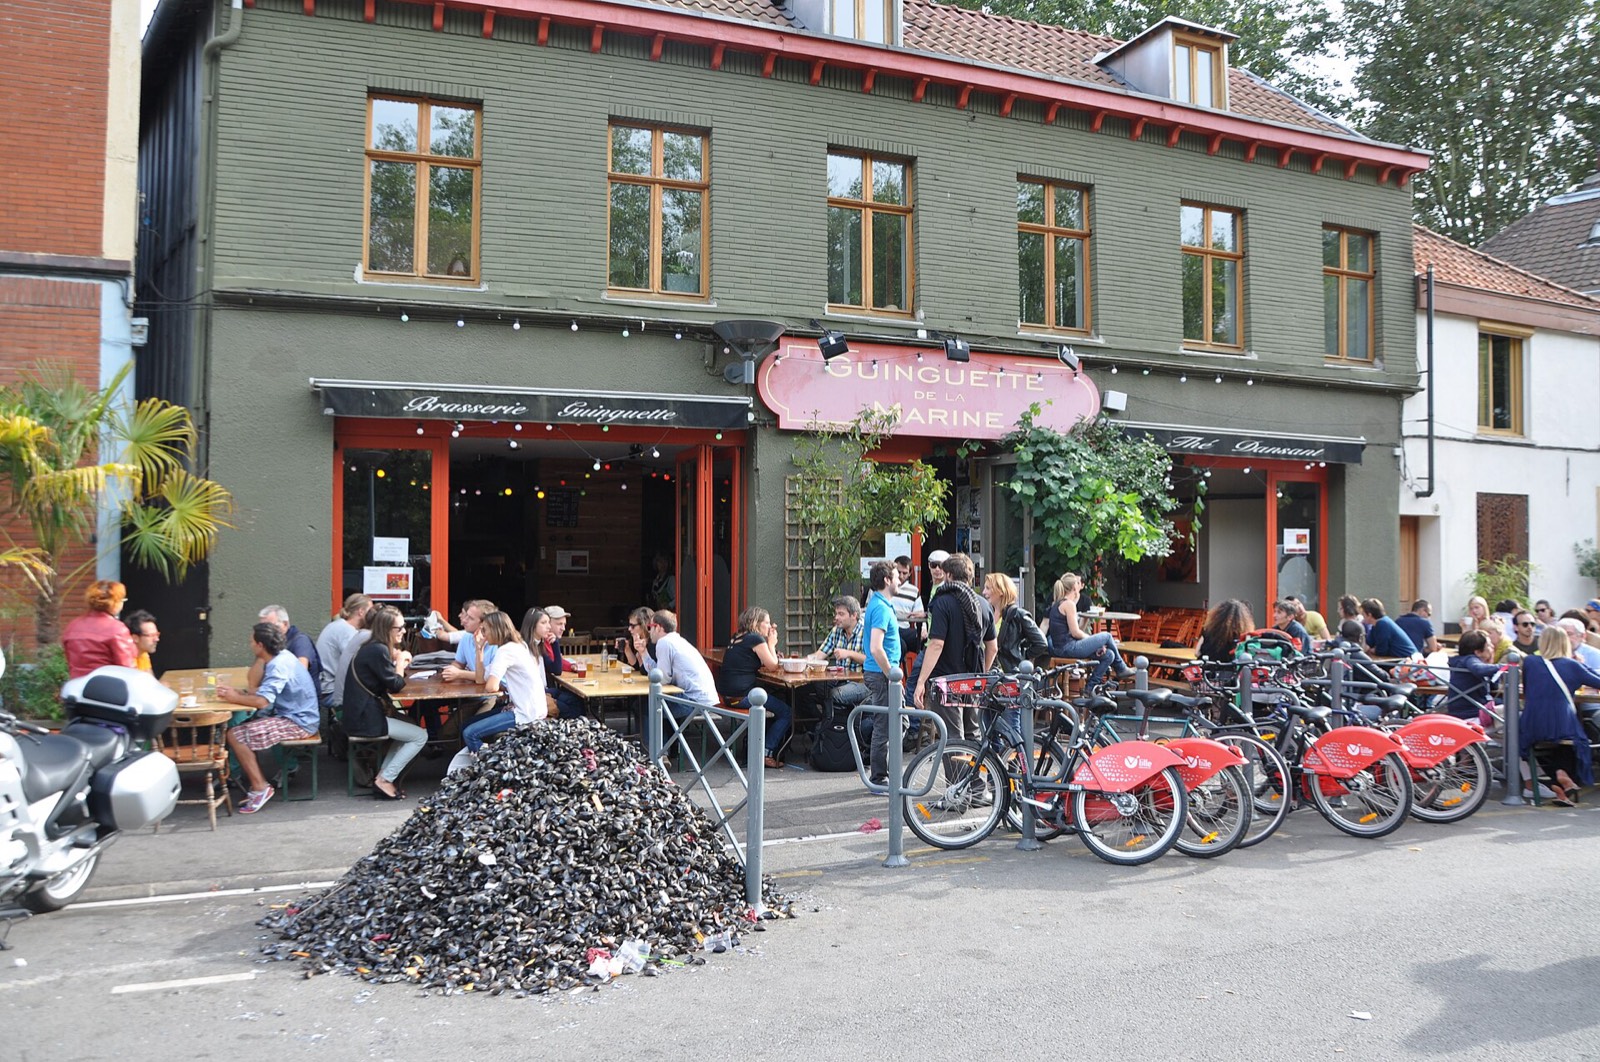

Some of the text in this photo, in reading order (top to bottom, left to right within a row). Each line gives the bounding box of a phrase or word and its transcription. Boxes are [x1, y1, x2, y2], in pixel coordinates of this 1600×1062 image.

[826, 356, 1044, 391] GUINGUETTE
[402, 395, 679, 425] Brasserie Guinguette
[914, 390, 966, 402] DE LA
[872, 400, 1005, 429] MARINE
[1166, 435, 1325, 457] Thé Dansant
